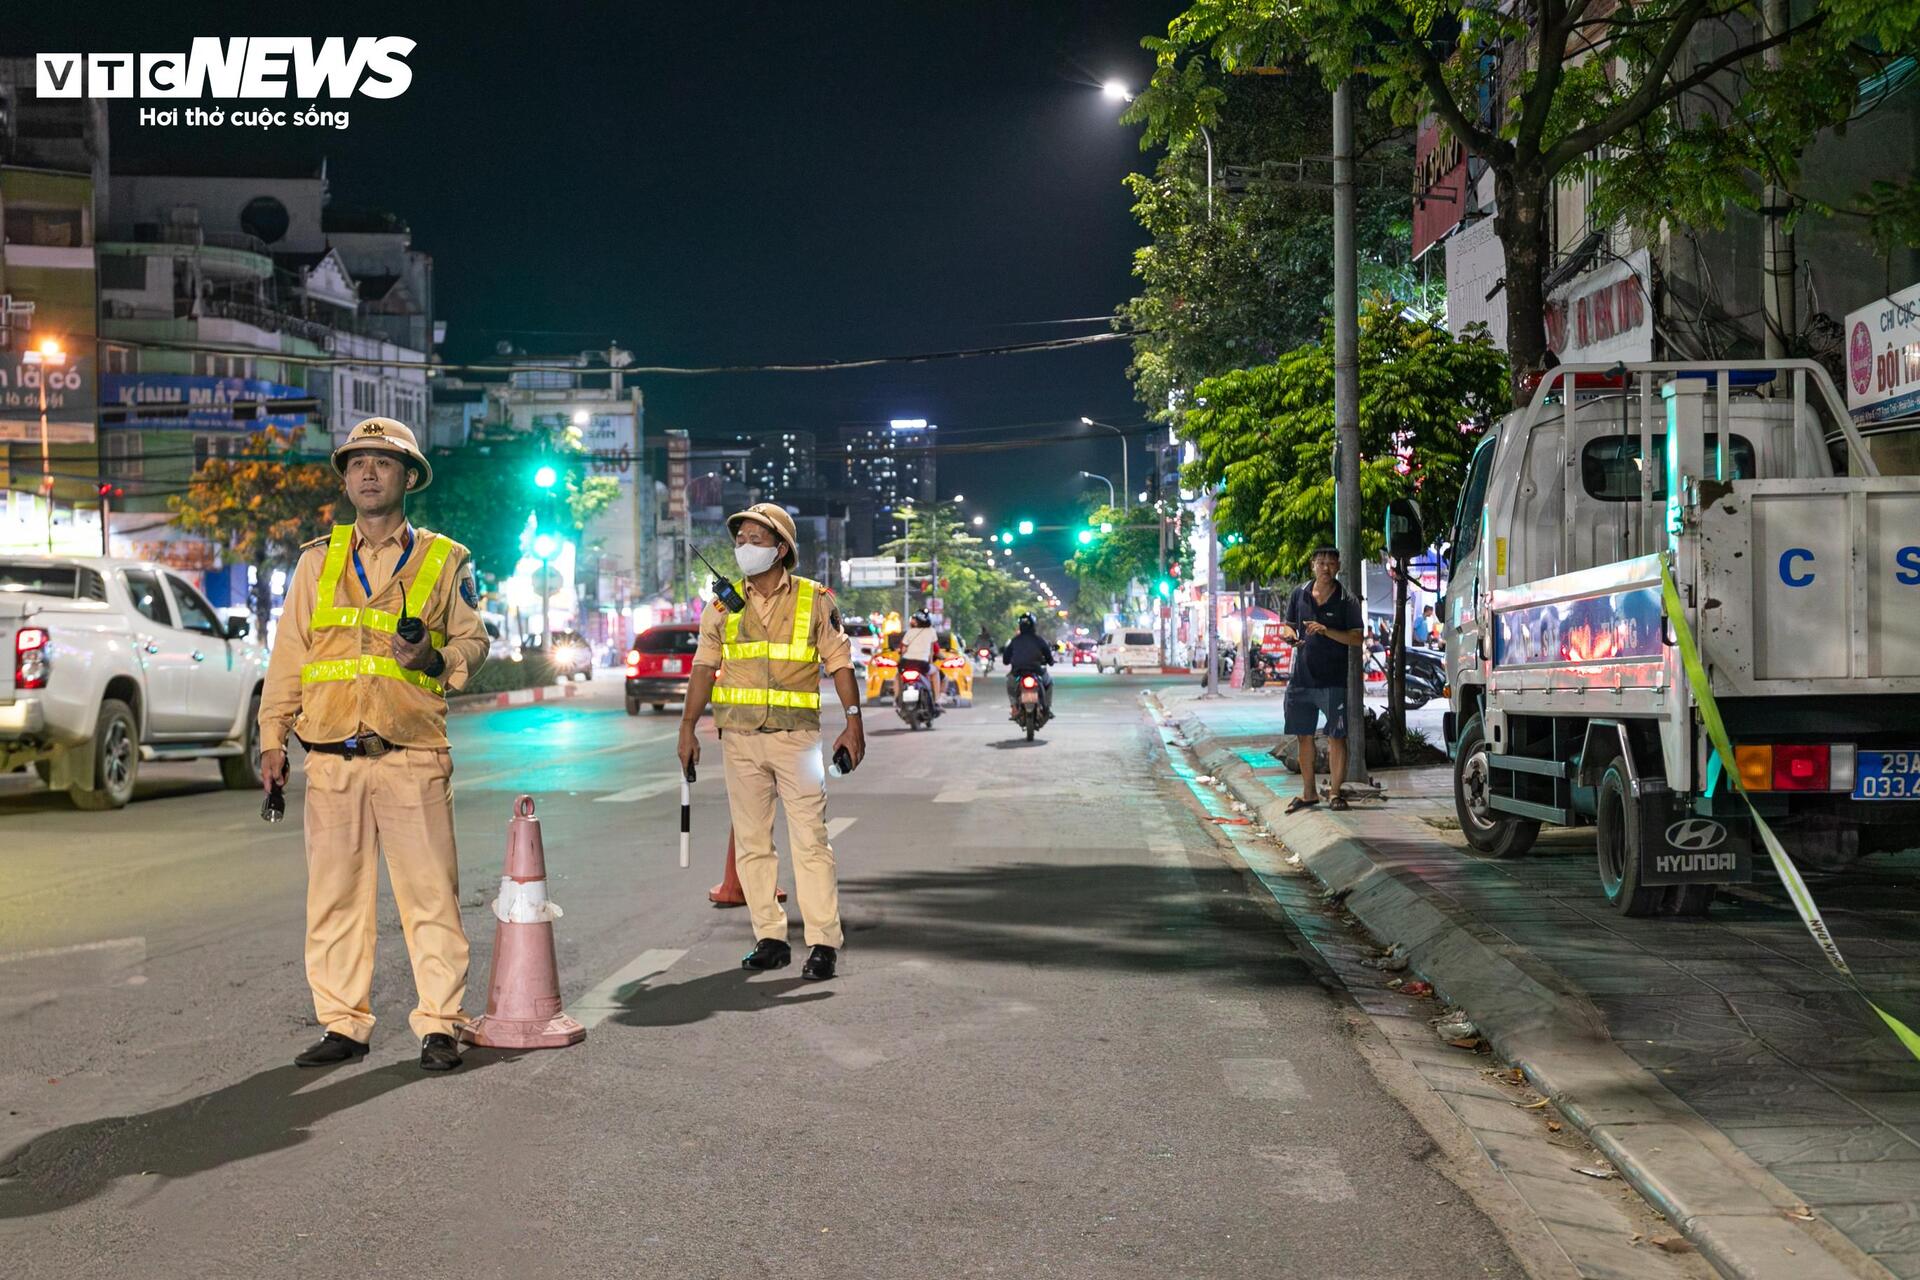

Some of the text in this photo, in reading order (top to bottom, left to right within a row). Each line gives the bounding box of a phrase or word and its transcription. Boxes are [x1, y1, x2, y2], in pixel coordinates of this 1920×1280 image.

[1880, 309, 1895, 333] CHI
[49, 365, 82, 390] có
[1877, 341, 1900, 396] ĐỘI
[1779, 547, 1816, 588] C
[1881, 753, 1920, 774] 29A
[1656, 853, 1736, 873] HYUNDAI
